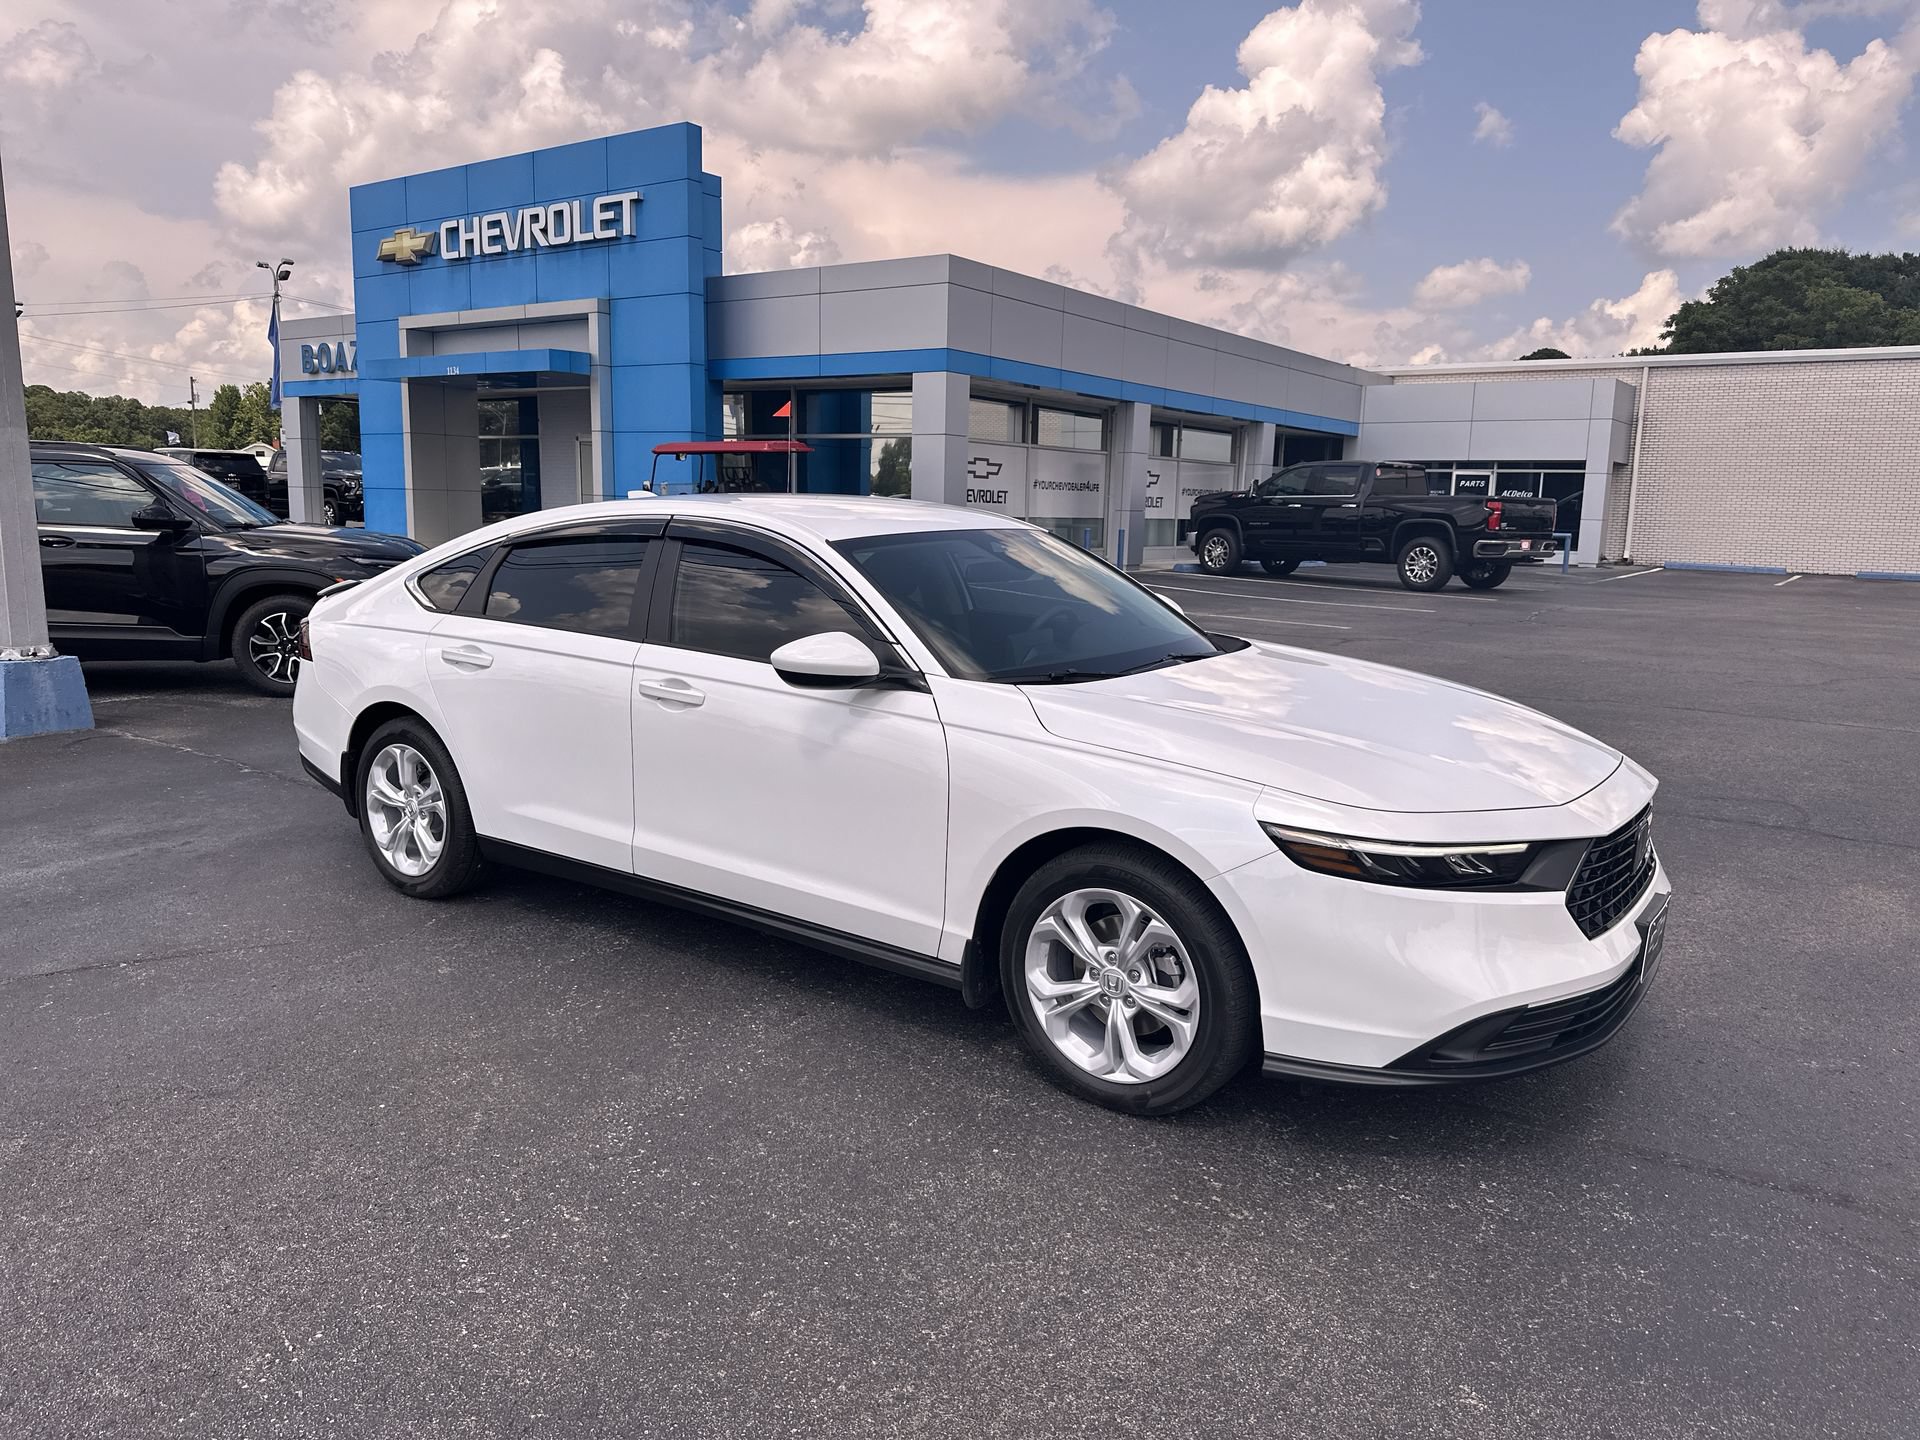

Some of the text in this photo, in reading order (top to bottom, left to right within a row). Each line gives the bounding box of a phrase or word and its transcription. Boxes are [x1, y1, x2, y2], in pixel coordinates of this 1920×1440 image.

[440, 191, 643, 261] CHEVROLET
[447, 366, 460, 375] 1134
[1033, 479, 1099, 492] #YOURCHEVYDEALER4LIFE
[1459, 480, 1486, 488] PARTS
[1501, 489, 1533, 498] ACDelco
